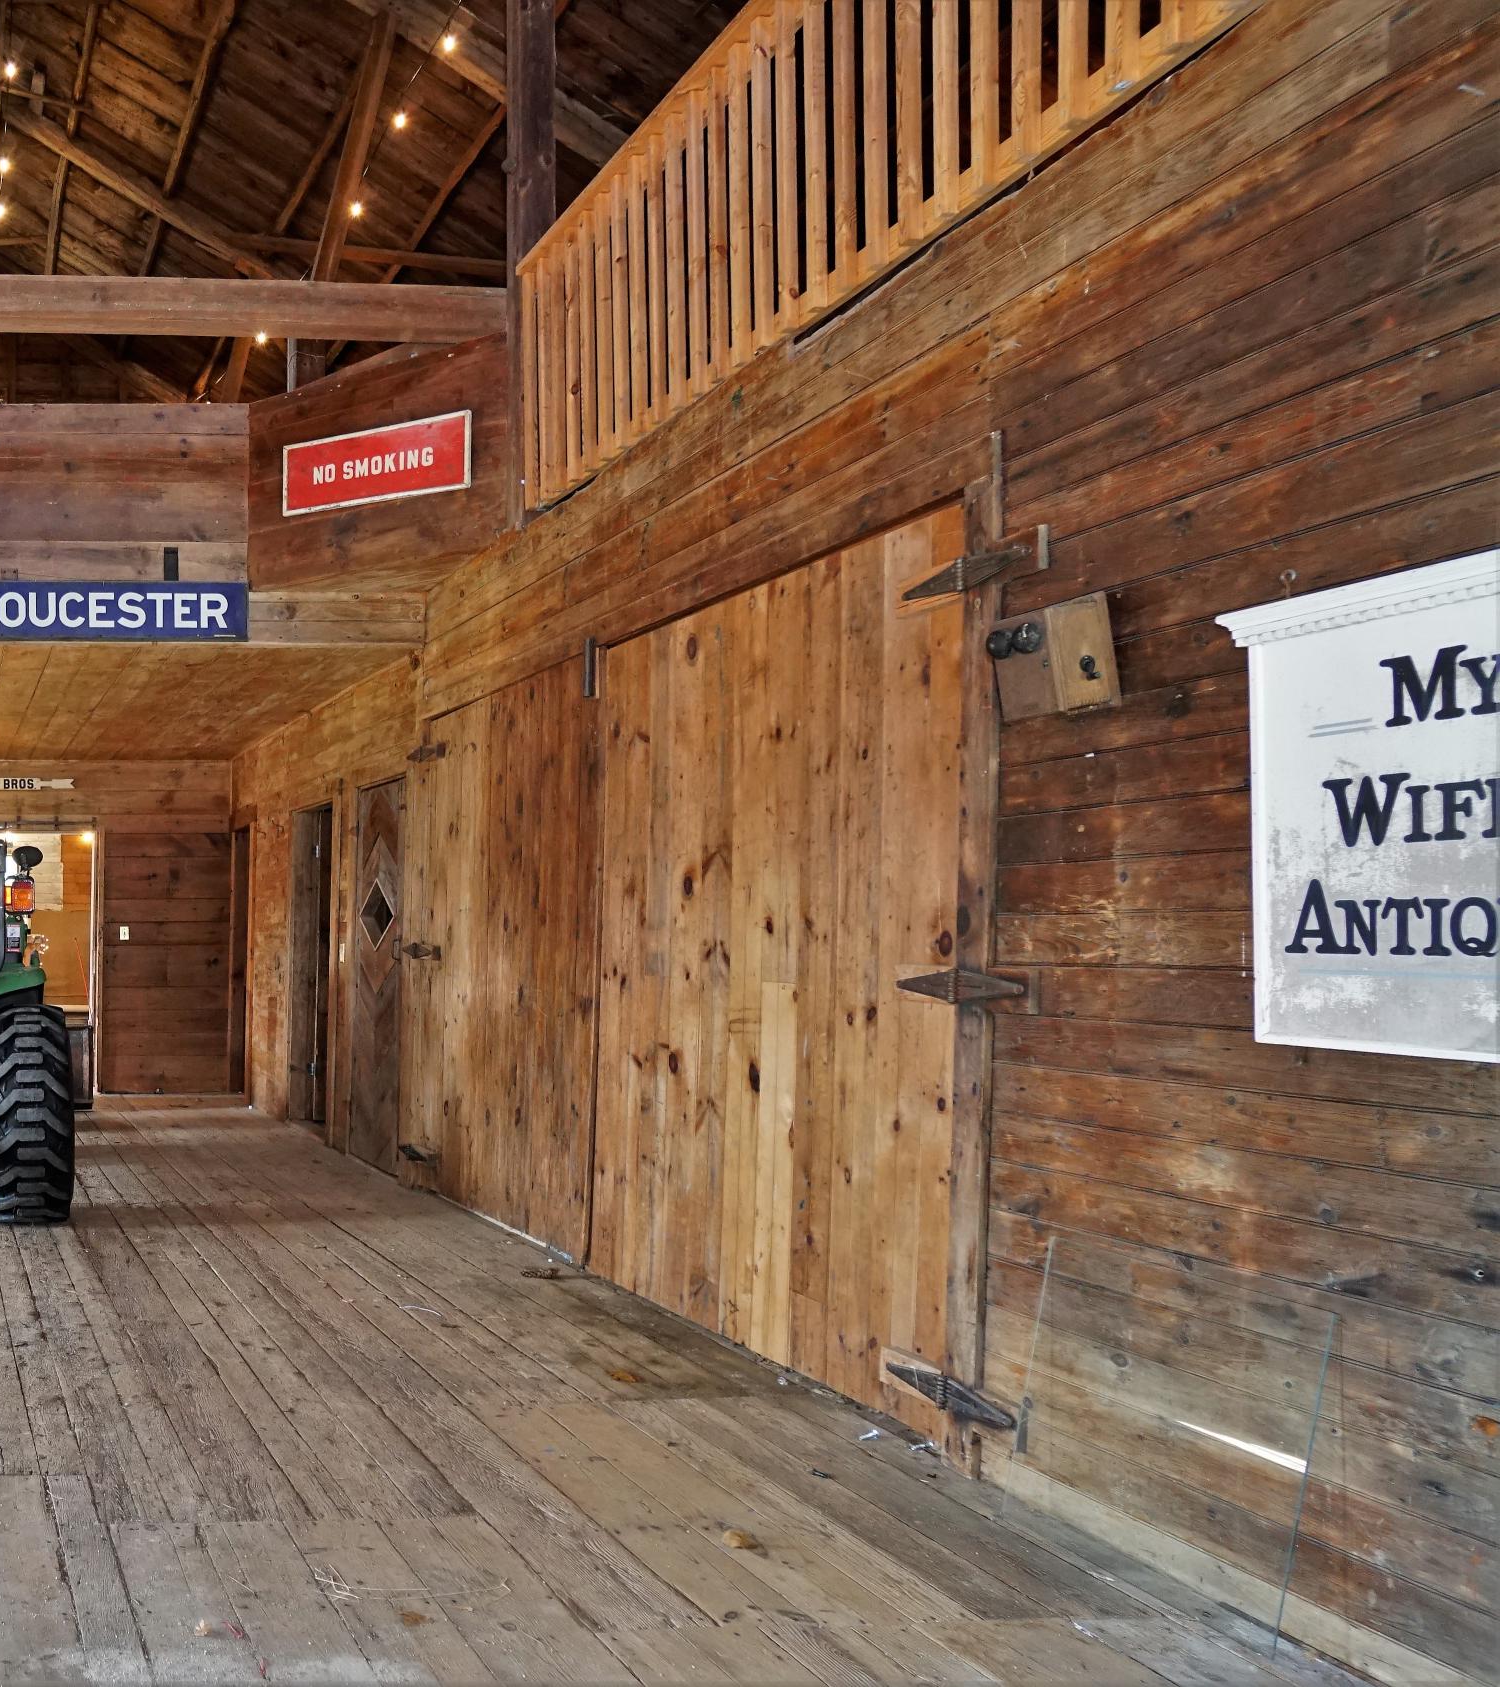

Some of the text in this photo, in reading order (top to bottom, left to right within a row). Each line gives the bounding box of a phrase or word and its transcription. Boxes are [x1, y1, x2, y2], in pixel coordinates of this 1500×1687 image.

[313, 446, 434, 485] NO SMOKING
[1284, 878, 1500, 957] ANTIQ
